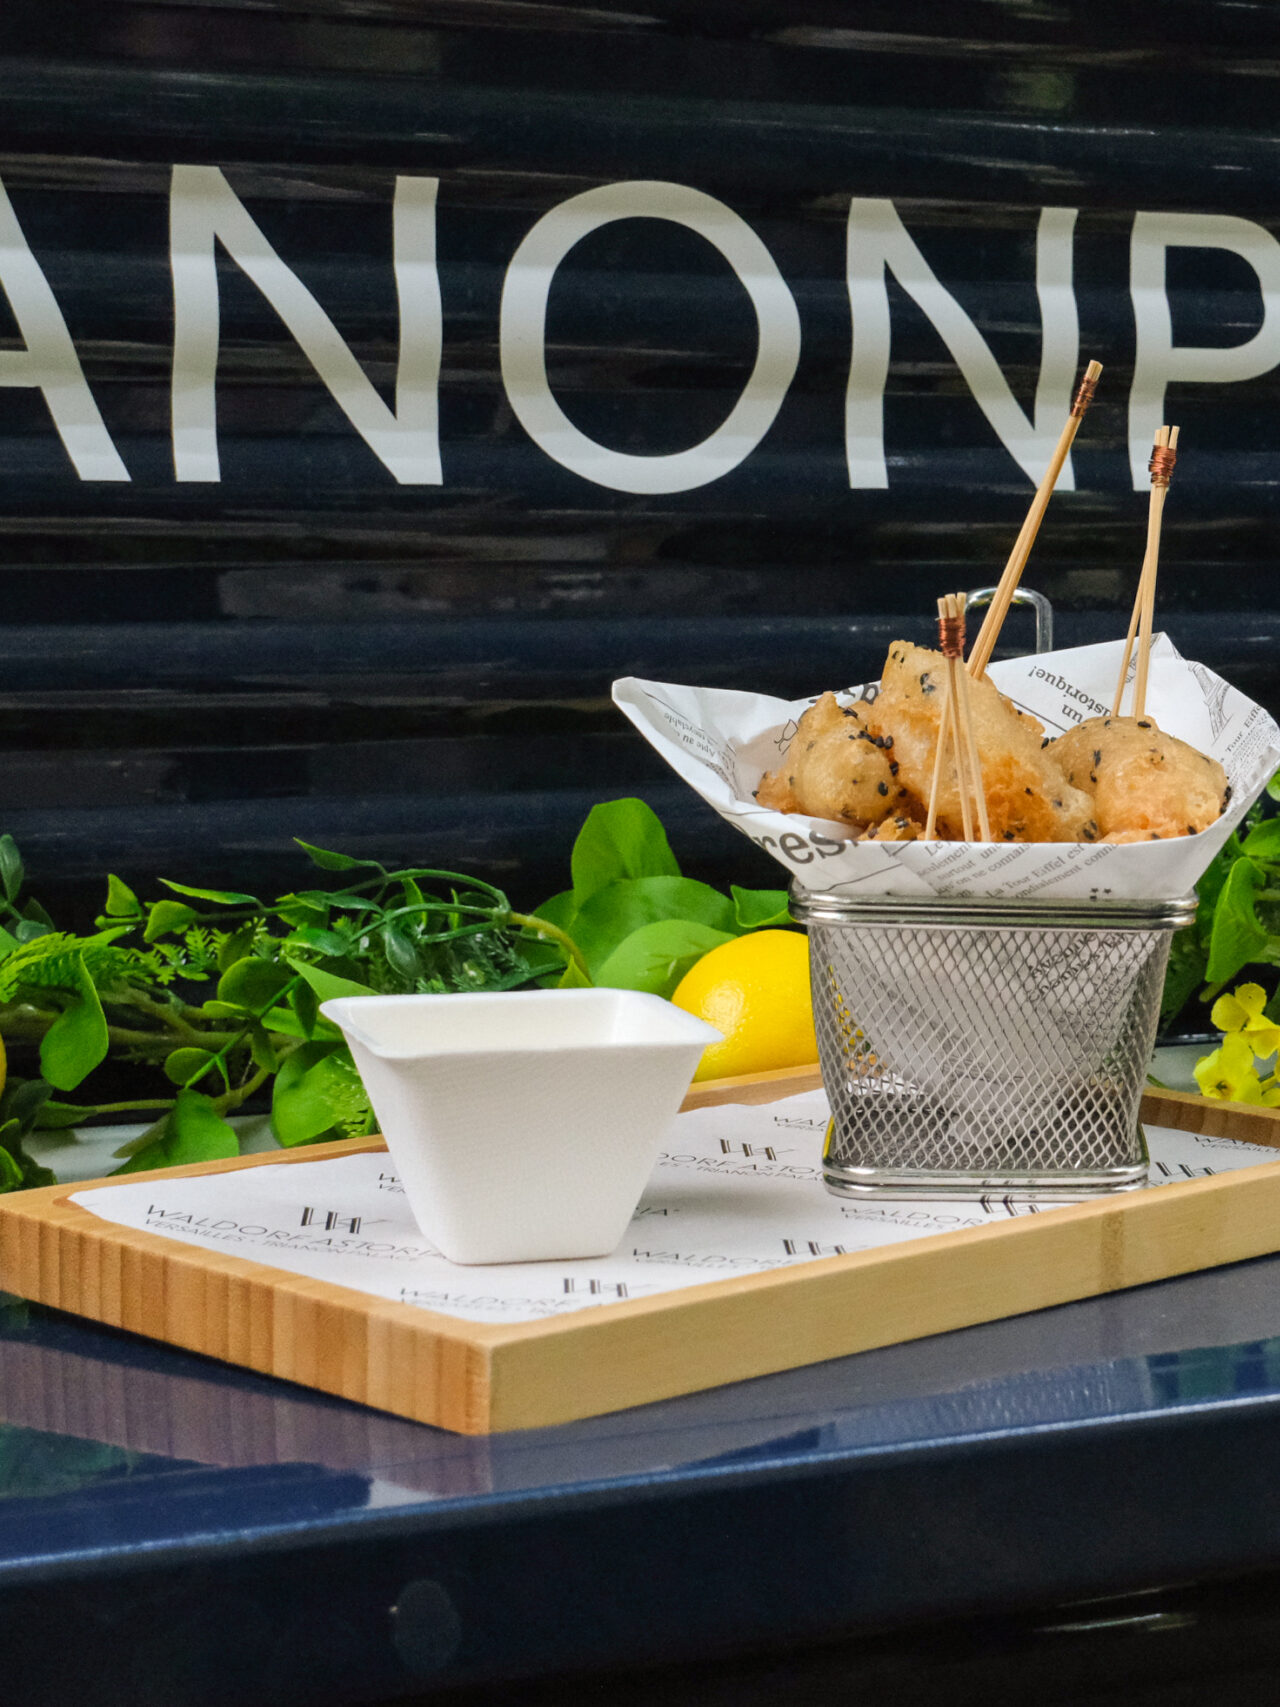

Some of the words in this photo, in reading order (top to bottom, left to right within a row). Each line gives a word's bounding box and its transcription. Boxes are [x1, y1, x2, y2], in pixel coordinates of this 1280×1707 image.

[1027, 665, 1112, 717] istorique!
[1061, 704, 1084, 724] un
[1032, 856, 1066, 879] Eiffel
[840, 1206, 984, 1226] WALDOR
[145, 1217, 243, 1243] VERSAILLES
[147, 1204, 312, 1241] WALDORF
[312, 1237, 447, 1260] ASTORIA
